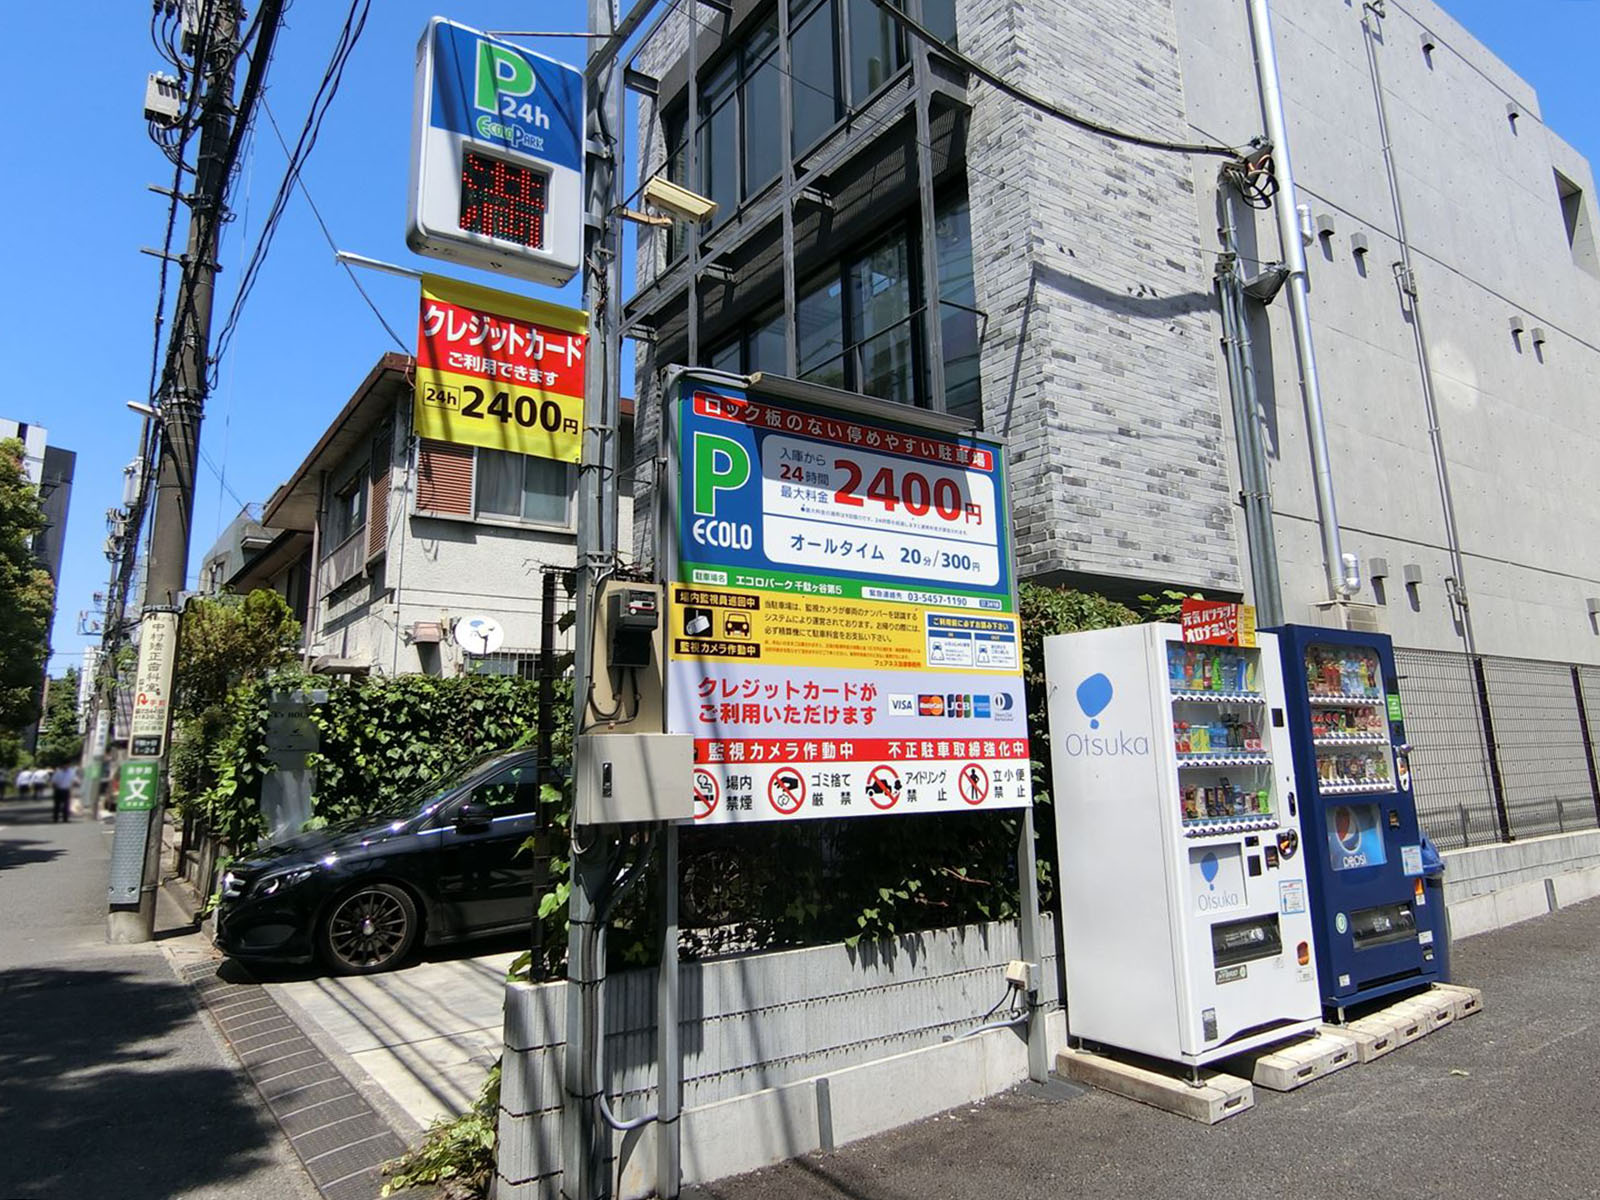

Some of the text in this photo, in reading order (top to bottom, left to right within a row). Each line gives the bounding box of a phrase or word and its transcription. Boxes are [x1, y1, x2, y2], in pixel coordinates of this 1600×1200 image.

[474, 39, 537, 115] P
[502, 97, 550, 129] 24h
[424, 304, 582, 367] クレジットカード
[448, 351, 558, 386] ご利用できます
[426, 388, 457, 405] 24h
[703, 397, 988, 468] ロック板のない停めやすい駐車場
[780, 447, 827, 467] 入庫から
[693, 431, 751, 517] P
[779, 463, 830, 487] 24時間
[780, 485, 829, 505] 最大料金
[692, 518, 753, 551] ECOLO
[789, 533, 886, 562] オールタイム
[679, 591, 756, 608] 場内監視員巡回中
[907, 592, 968, 606] 03-5457-1190
[679, 641, 757, 656] 監視カメラ作動中
[698, 676, 879, 702] クレジットカードが
[698, 702, 878, 726] ご利用いただけます
[892, 699, 913, 710] VISA
[707, 741, 855, 762] 監視カメラ作動中
[887, 740, 1025, 759] 不正駐車取締強化中
[1065, 730, 1149, 757] Otsuka
[725, 775, 753, 791] 場内
[811, 772, 852, 788] ゴミ捨て
[905, 769, 948, 785] アイドリング
[992, 768, 1026, 783] 立小便
[725, 794, 753, 812] 禁煙
[1197, 891, 1239, 911] Otsuka
